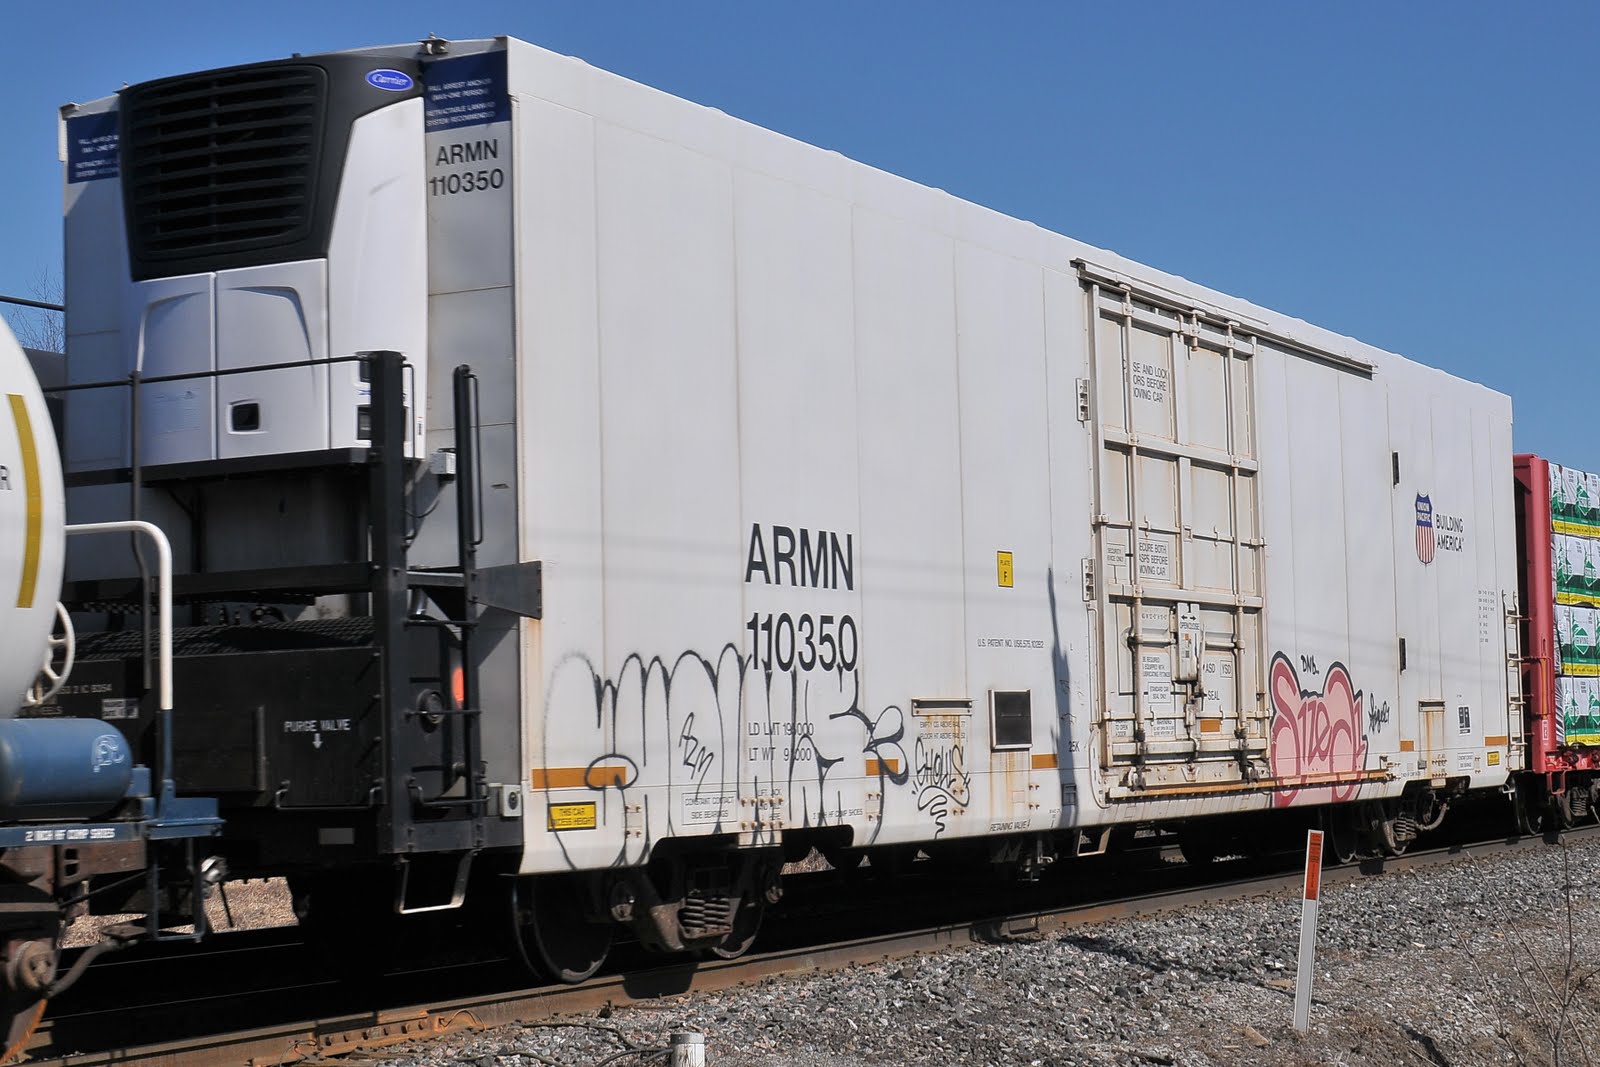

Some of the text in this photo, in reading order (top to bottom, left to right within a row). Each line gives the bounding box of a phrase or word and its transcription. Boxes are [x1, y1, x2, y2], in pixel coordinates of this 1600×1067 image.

[435, 139, 499, 167] ARMN
[428, 168, 504, 197] 110350
[1142, 363, 1153, 376] AND
[1132, 374, 1167, 392] ORS BEFORE
[1133, 387, 1164, 403] OVING CAR
[1435, 513, 1464, 533] BUILDING
[1138, 541, 1154, 553] ECURE
[744, 522, 855, 591] ARMN
[1151, 555, 1168, 566] BEFORE
[1156, 566, 1166, 576] CAR
[746, 611, 858, 672] 110350
[987, 638, 1004, 648] PATENT
[1207, 689, 1221, 701] SEAL
[284, 718, 351, 732] PURGE VALVE
[748, 722, 760, 736] LD
[748, 746, 812, 762] LT WT 9000
[848, 807, 863, 817] SHOES
[990, 820, 1027, 832] RETAINING VALVE
